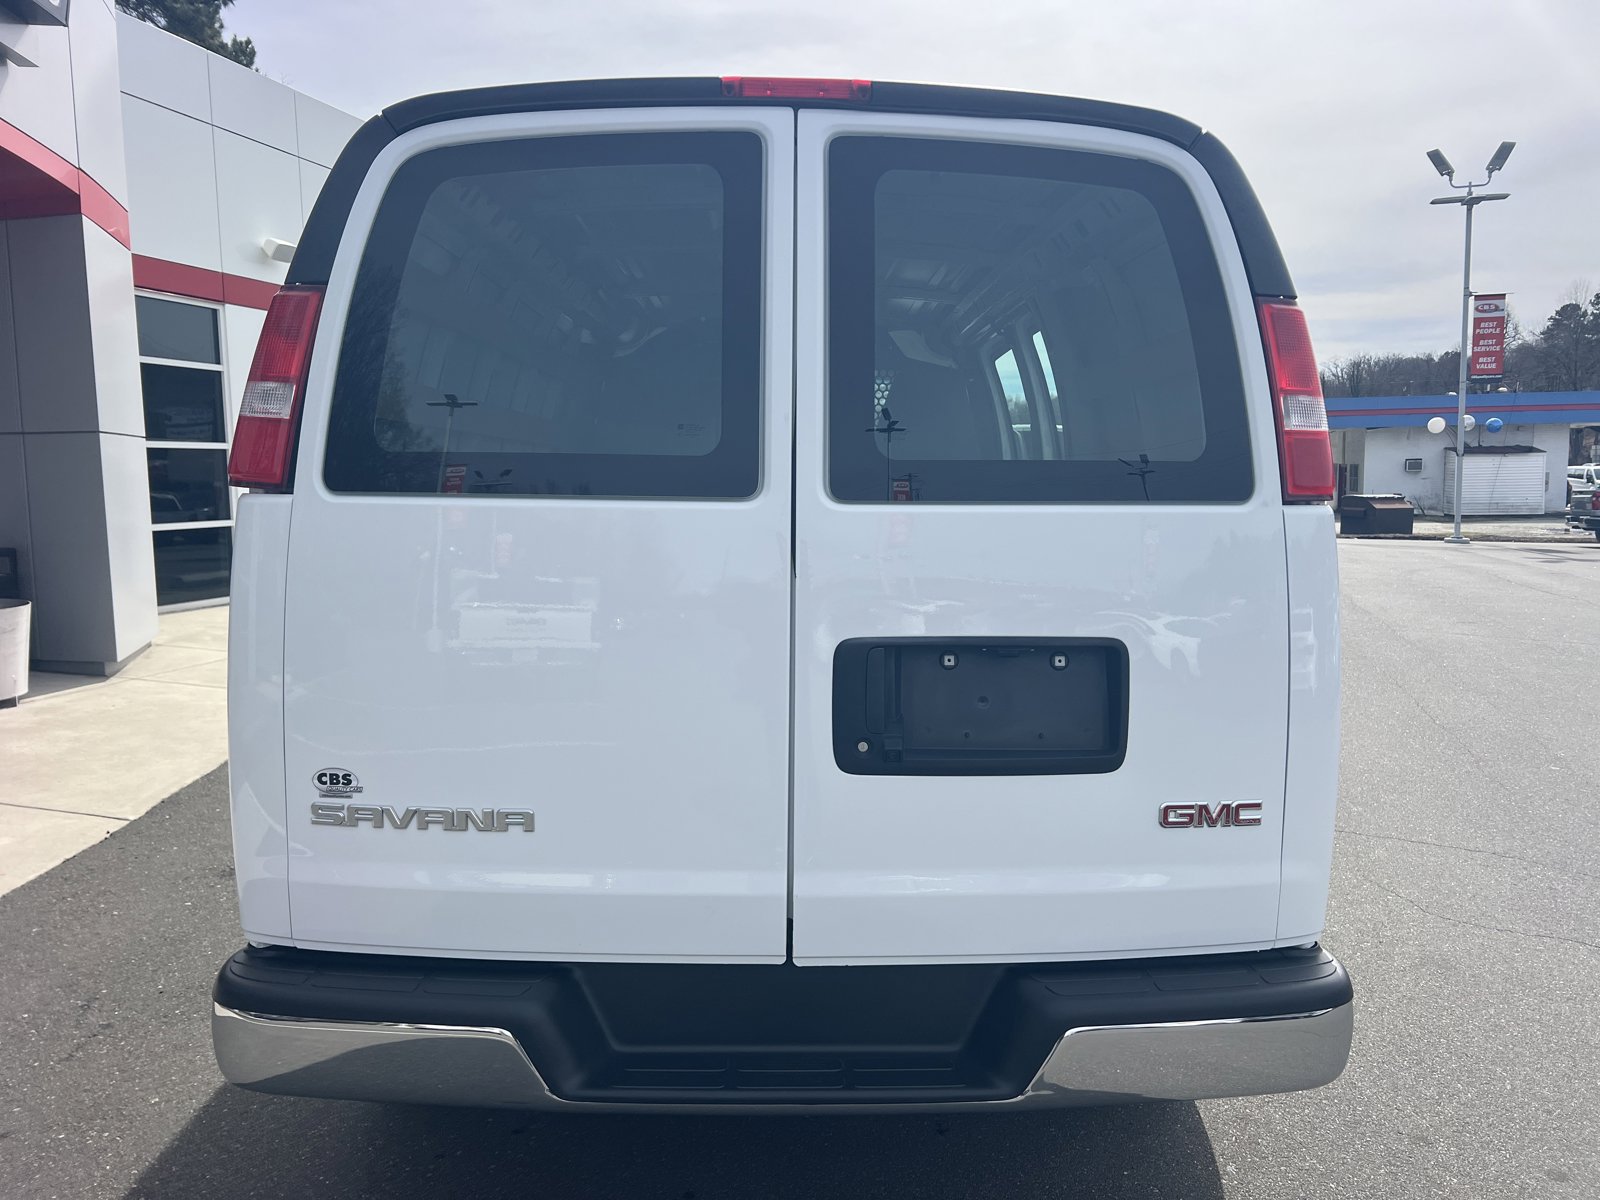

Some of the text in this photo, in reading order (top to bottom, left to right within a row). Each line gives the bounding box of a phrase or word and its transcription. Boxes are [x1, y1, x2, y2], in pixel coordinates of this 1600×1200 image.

[317, 772, 353, 786] CBS
[310, 801, 535, 832] SAVANA
[1158, 799, 1262, 828] GMC
